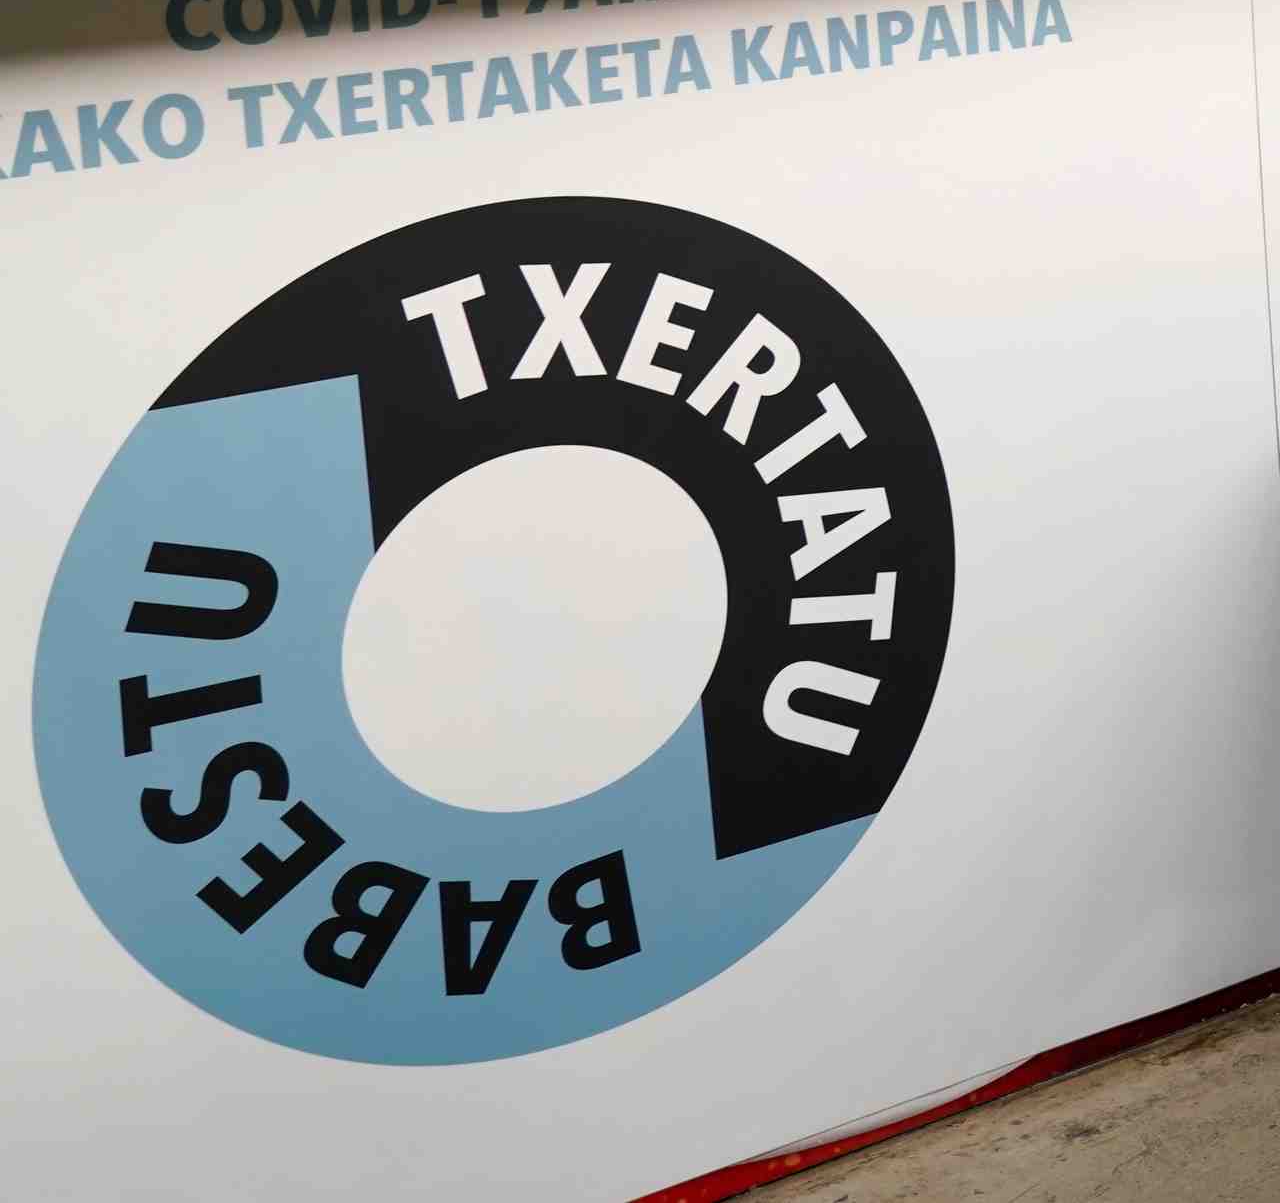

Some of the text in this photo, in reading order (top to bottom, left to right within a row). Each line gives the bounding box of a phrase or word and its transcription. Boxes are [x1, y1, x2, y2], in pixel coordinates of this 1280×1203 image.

[0, 92, 205, 181] AKO
[227, 35, 712, 149] TXERTAKETA
[402, 262, 897, 756] TXERTATU
[119, 541, 642, 997] BABESTU
